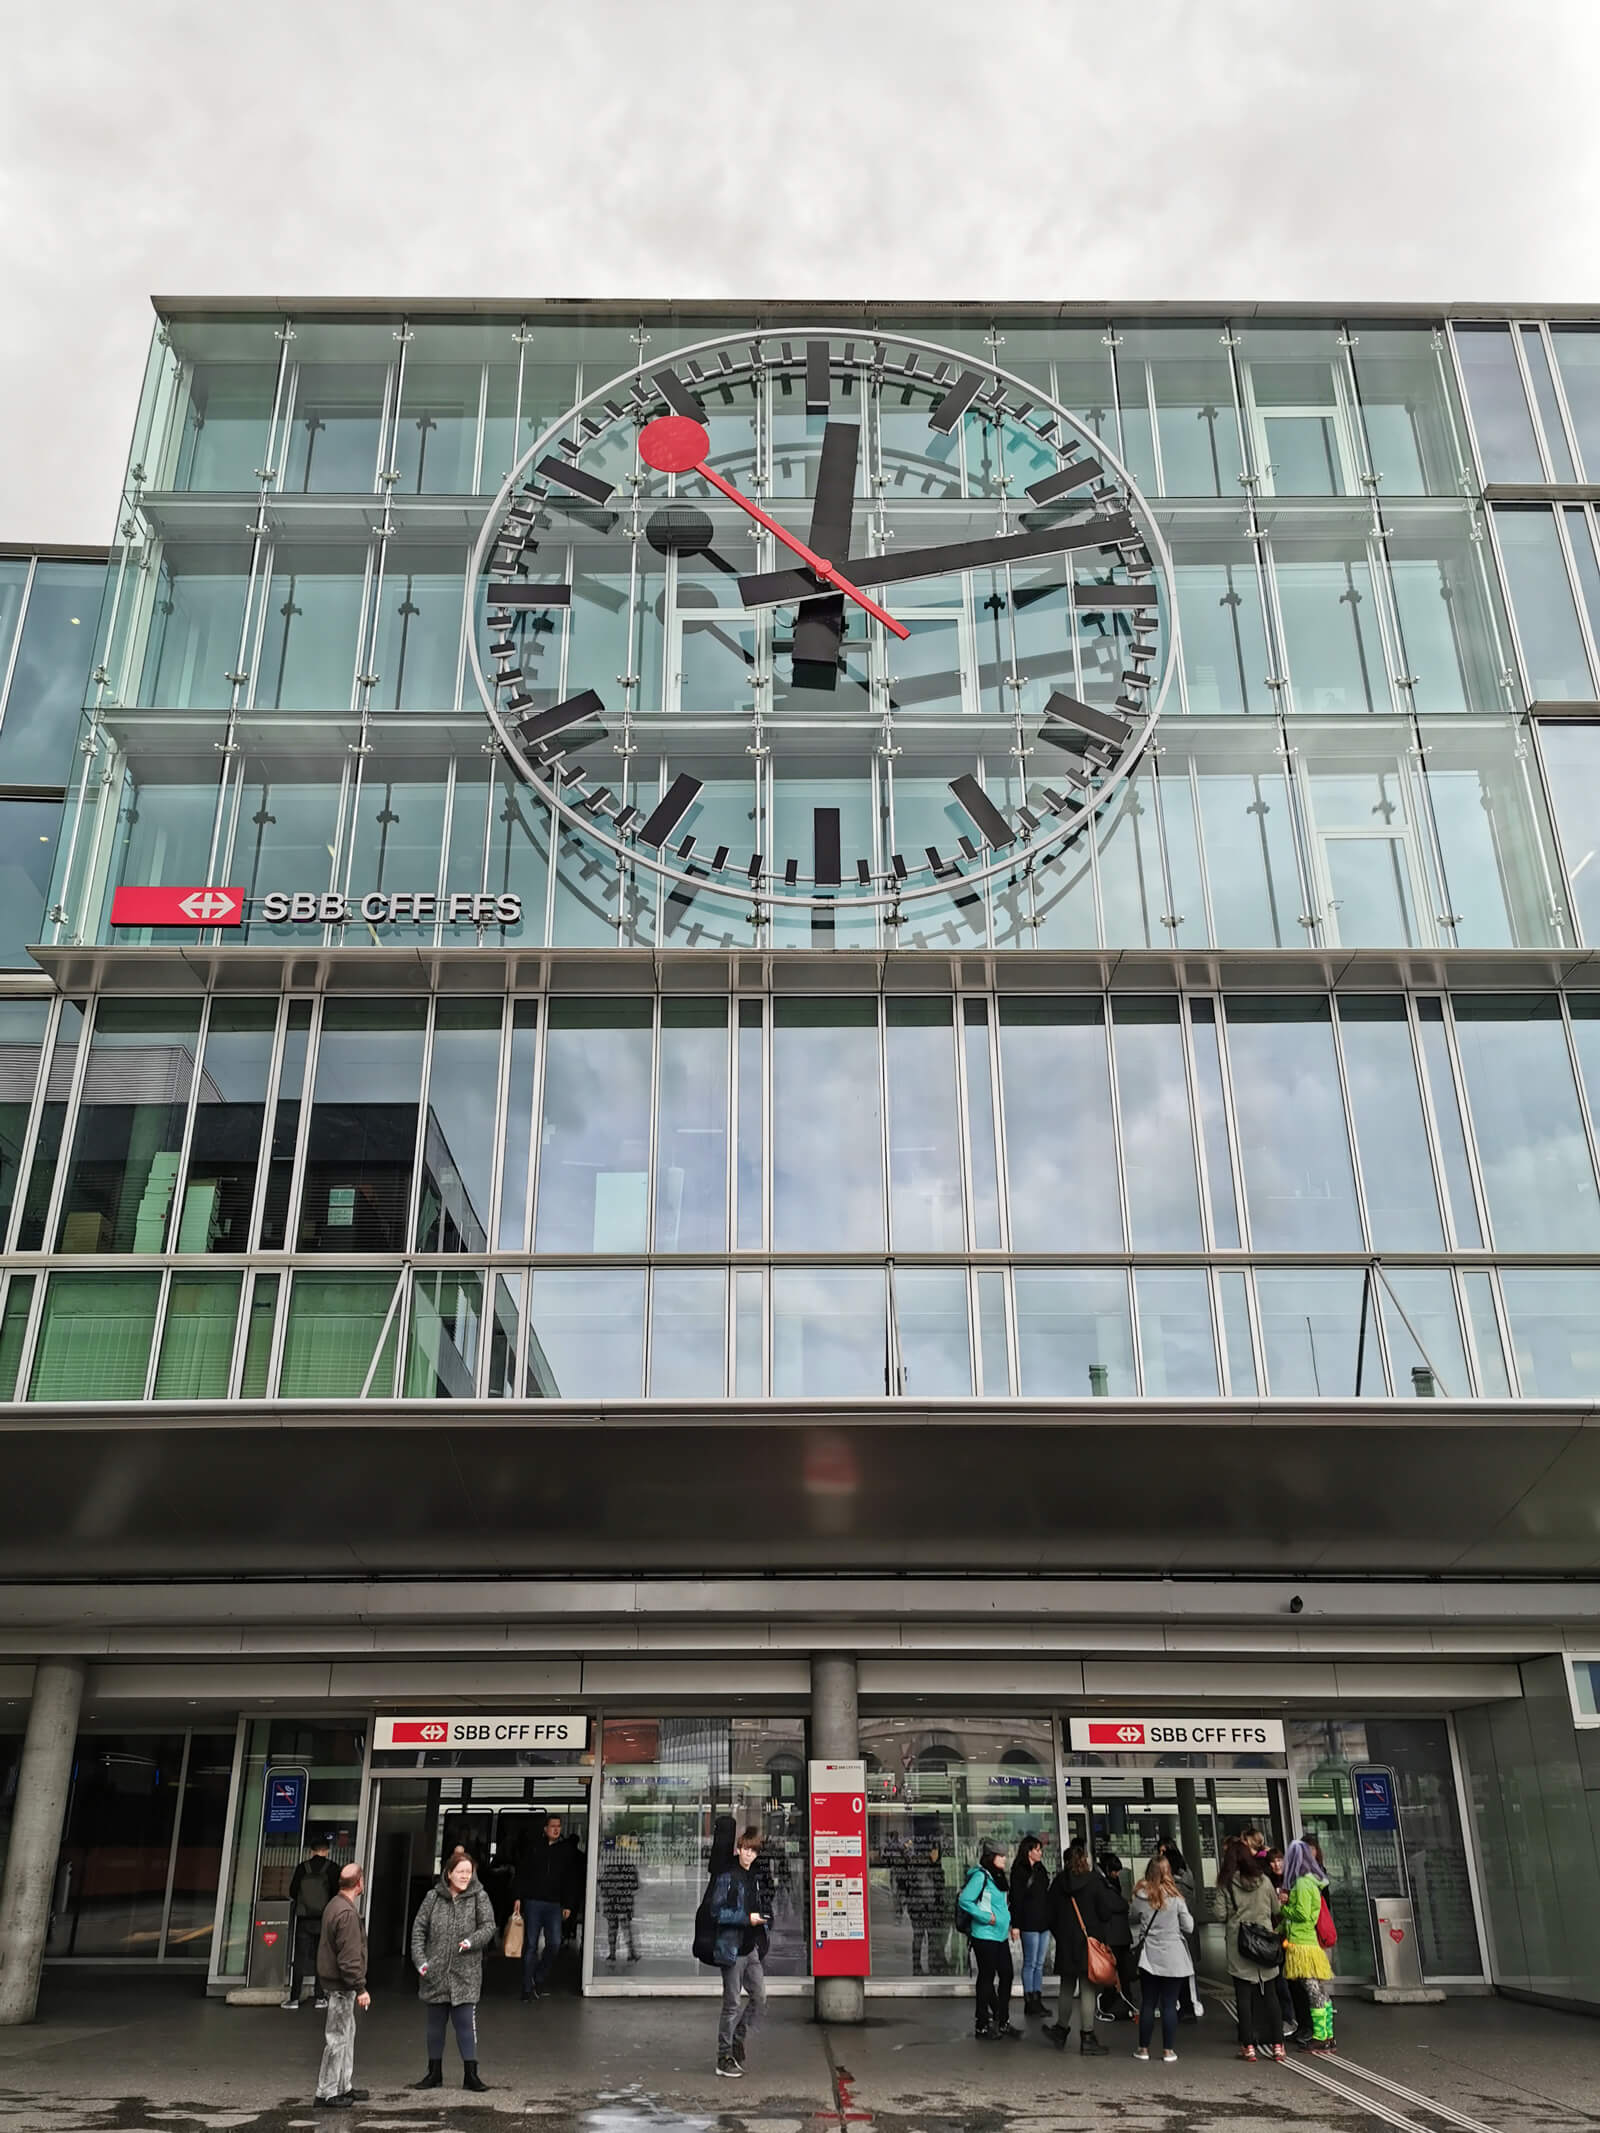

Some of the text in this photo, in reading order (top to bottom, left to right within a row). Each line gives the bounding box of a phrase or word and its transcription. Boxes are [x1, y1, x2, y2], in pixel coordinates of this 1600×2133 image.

[262, 892, 522, 924] SBB CFF FFS
[453, 1725, 568, 1740] SBB CFF FFS
[1150, 1727, 1267, 1743] SBB CFF FFS
[852, 1797, 863, 1813] 0
